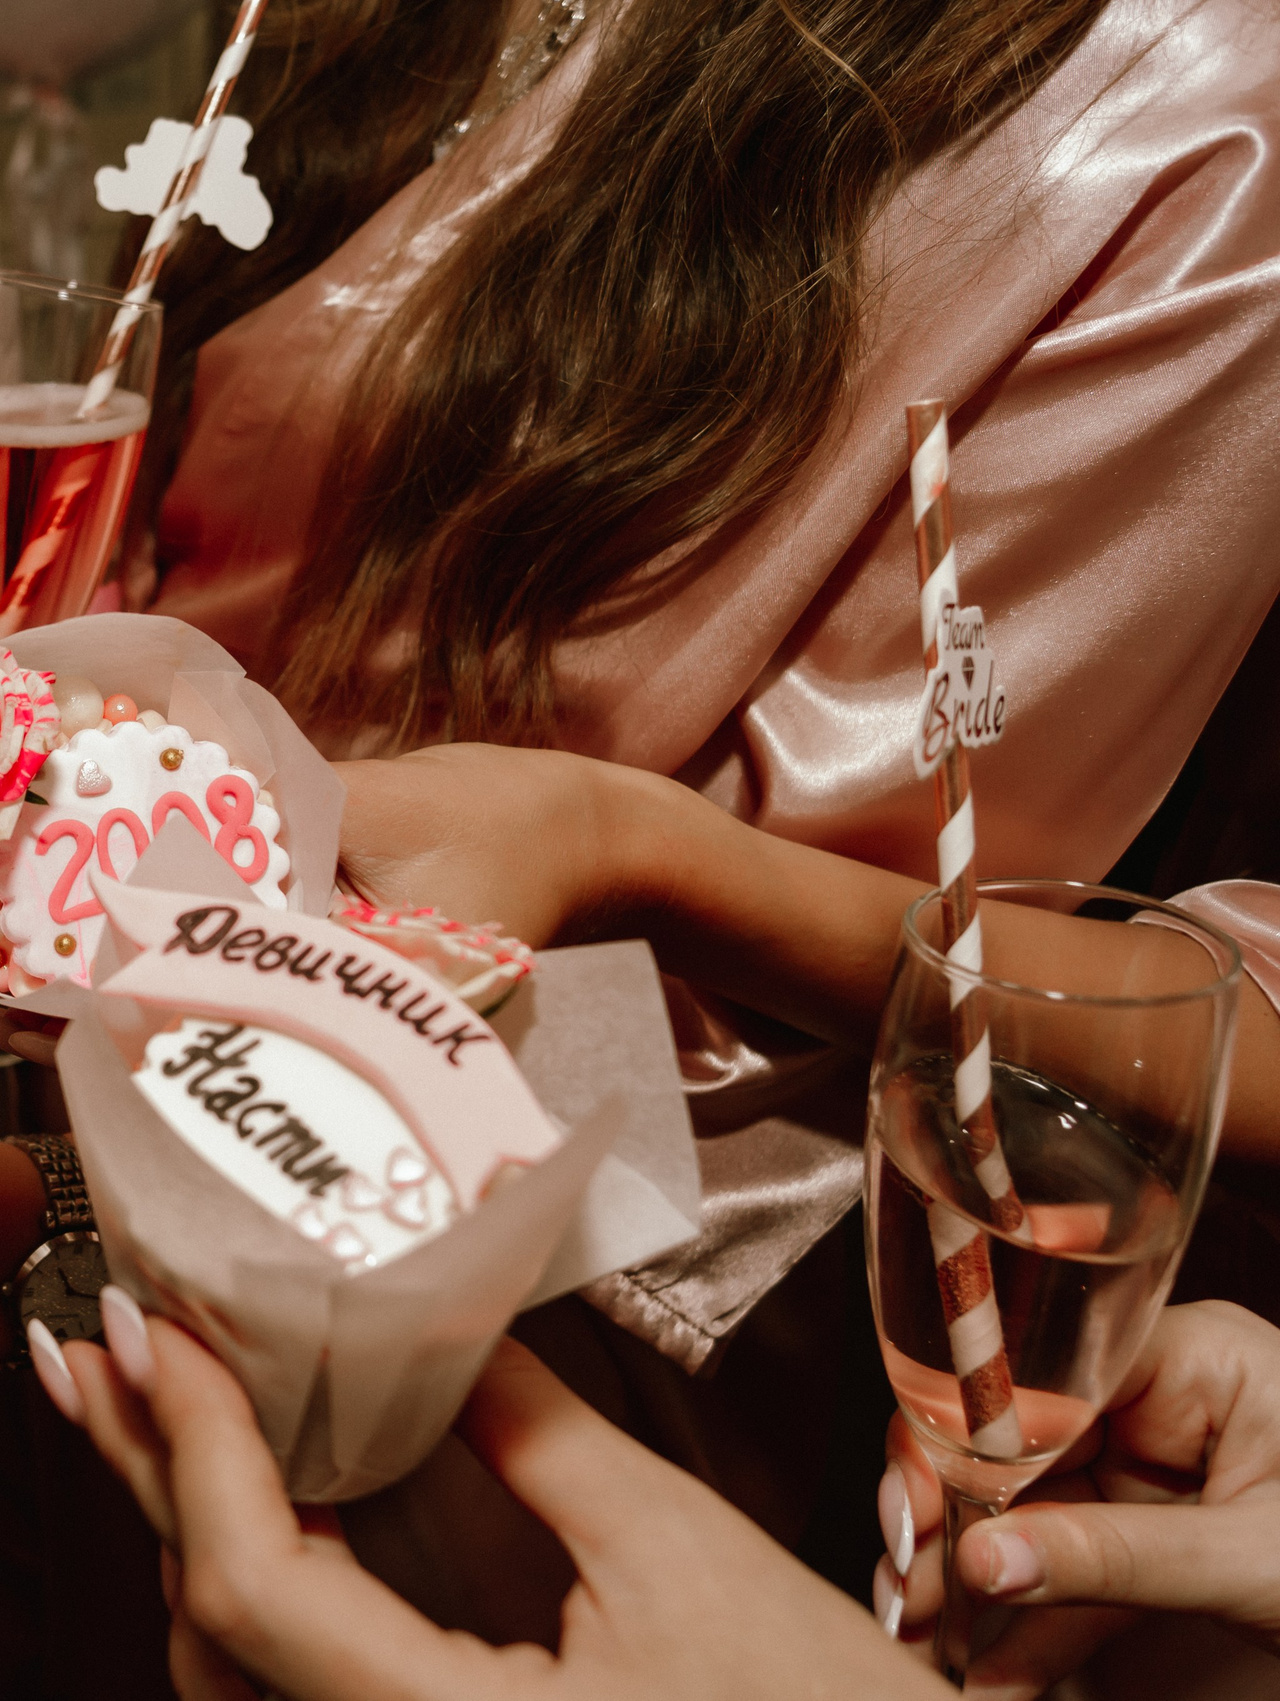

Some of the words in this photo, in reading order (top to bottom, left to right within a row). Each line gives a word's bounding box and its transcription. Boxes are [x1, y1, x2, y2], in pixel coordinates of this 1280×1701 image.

[943, 603, 986, 650] Team
[923, 660, 1005, 763] Bride
[162, 905, 494, 1067] Девичник
